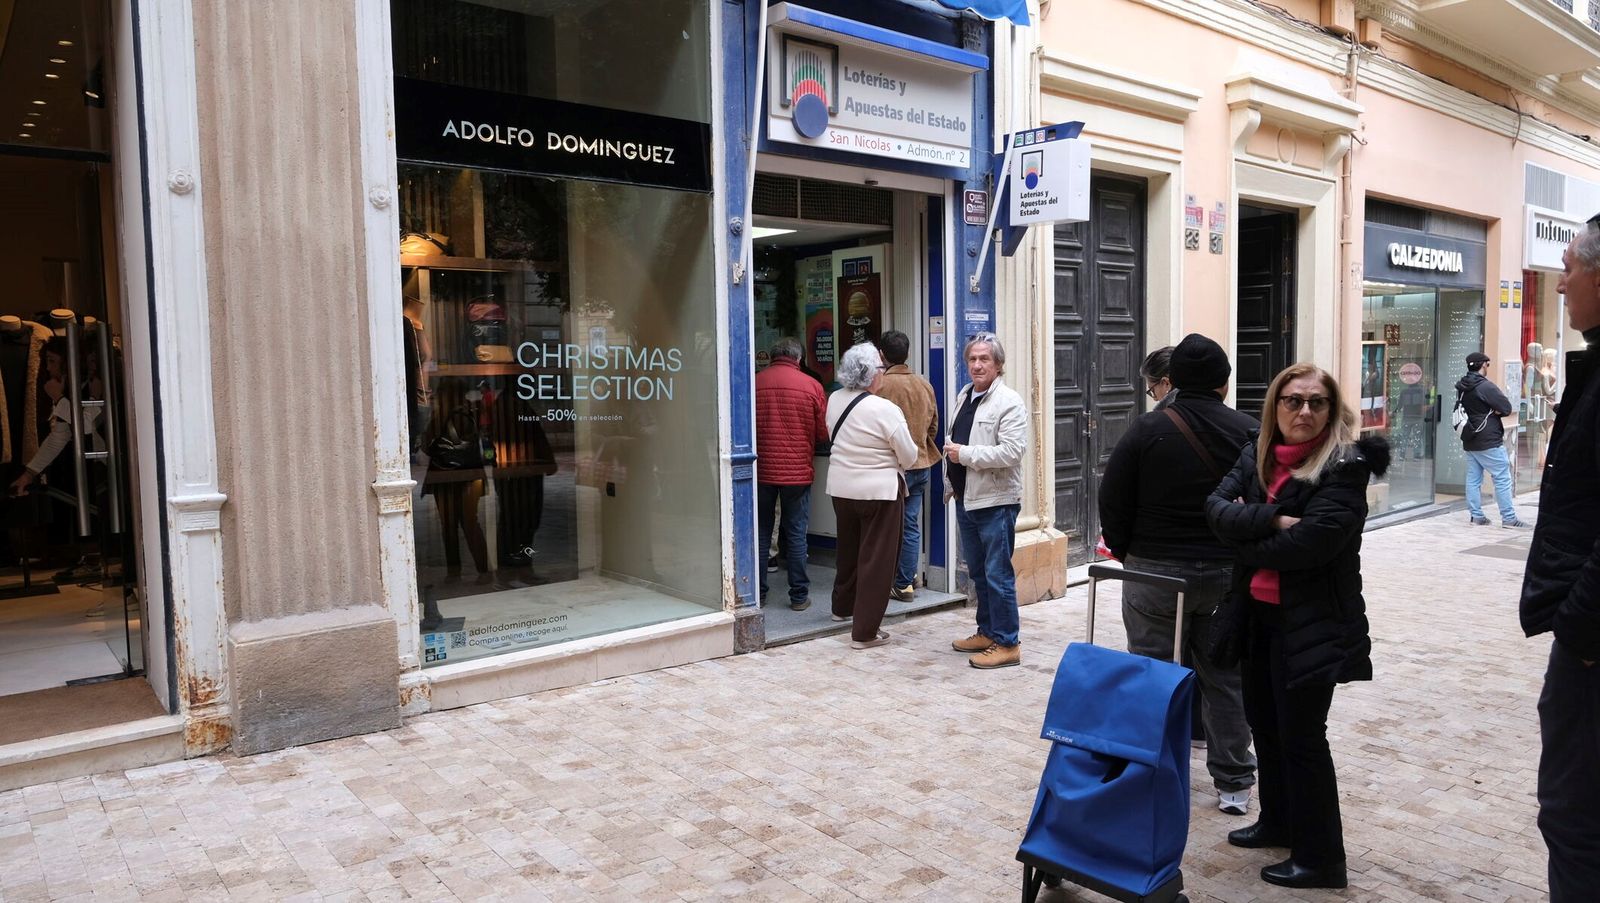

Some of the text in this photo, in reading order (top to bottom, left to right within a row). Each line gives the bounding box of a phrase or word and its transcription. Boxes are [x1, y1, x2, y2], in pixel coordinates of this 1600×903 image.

[844, 66, 907, 96] Loterías y
[844, 96, 967, 132] Apuestas del Estado
[442, 119, 675, 165] ADOLFO DOMINGUEZ
[829, 130, 849, 145] San
[959, 151, 966, 163] 2
[1020, 196, 1058, 209] Apuestas del
[1045, 190, 1049, 198] y
[1019, 208, 1040, 217] Estado
[1389, 242, 1464, 273] CALZEDONIA
[516, 341, 682, 372] CHRISTMAS
[516, 373, 673, 400] SELECTION
[518, 414, 540, 422] Hasta
[541, 409, 577, 421] -50%
[468, 613, 568, 637] adolfodominguez.com
[468, 636, 499, 647] Compra
[500, 632, 525, 642] online,
[526, 627, 550, 637] recoge
